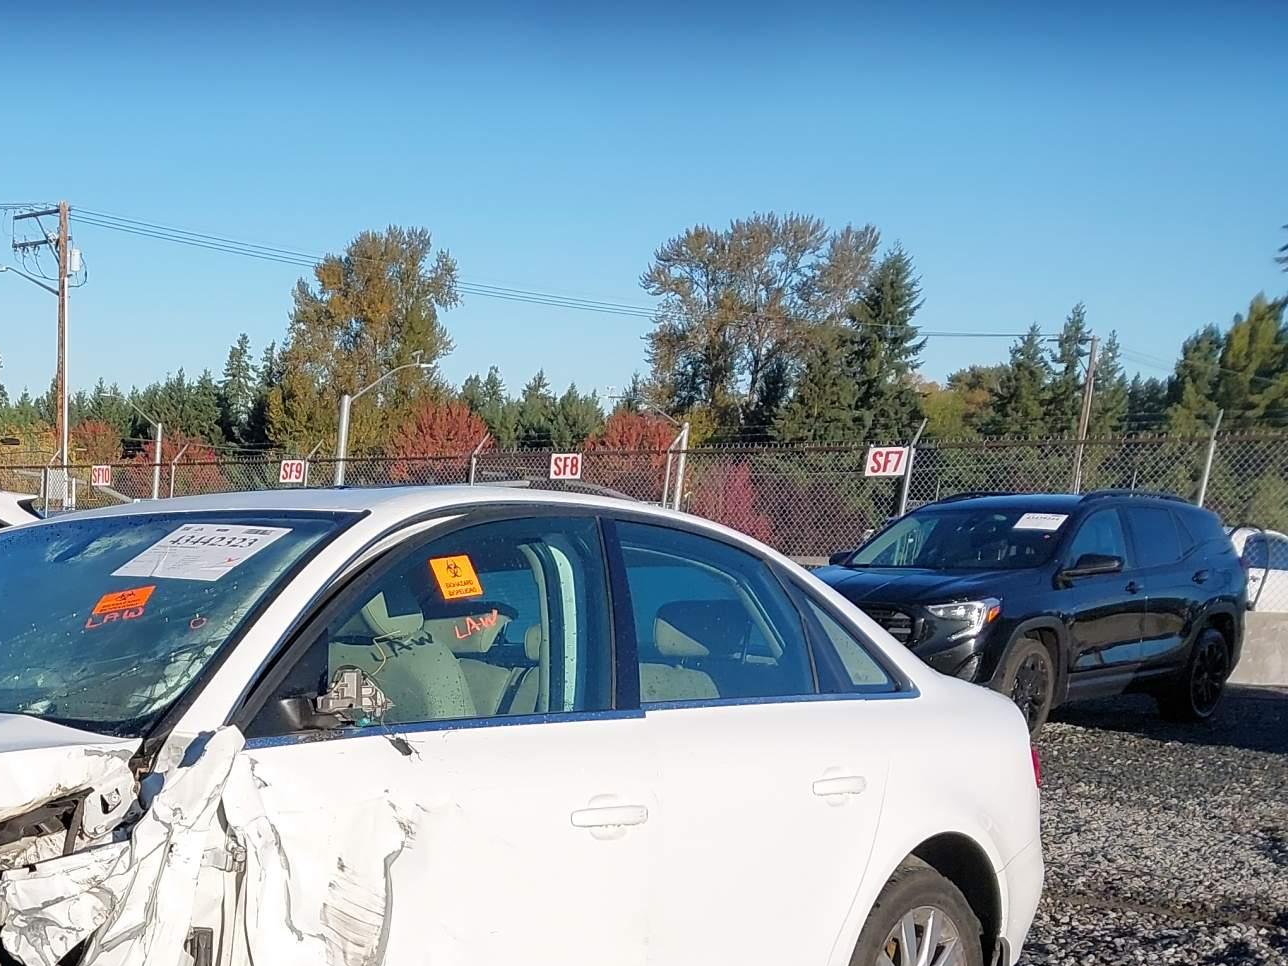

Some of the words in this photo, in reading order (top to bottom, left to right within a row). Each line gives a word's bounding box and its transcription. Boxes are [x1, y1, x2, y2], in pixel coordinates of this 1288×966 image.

[282, 462, 302, 480] SF9
[553, 456, 579, 476] SF8
[870, 450, 904, 473] SF7
[92, 467, 110, 484] SF10
[169, 534, 259, 549] 43442323
[85, 606, 145, 628] LAW
[454, 608, 499, 639] LAW
